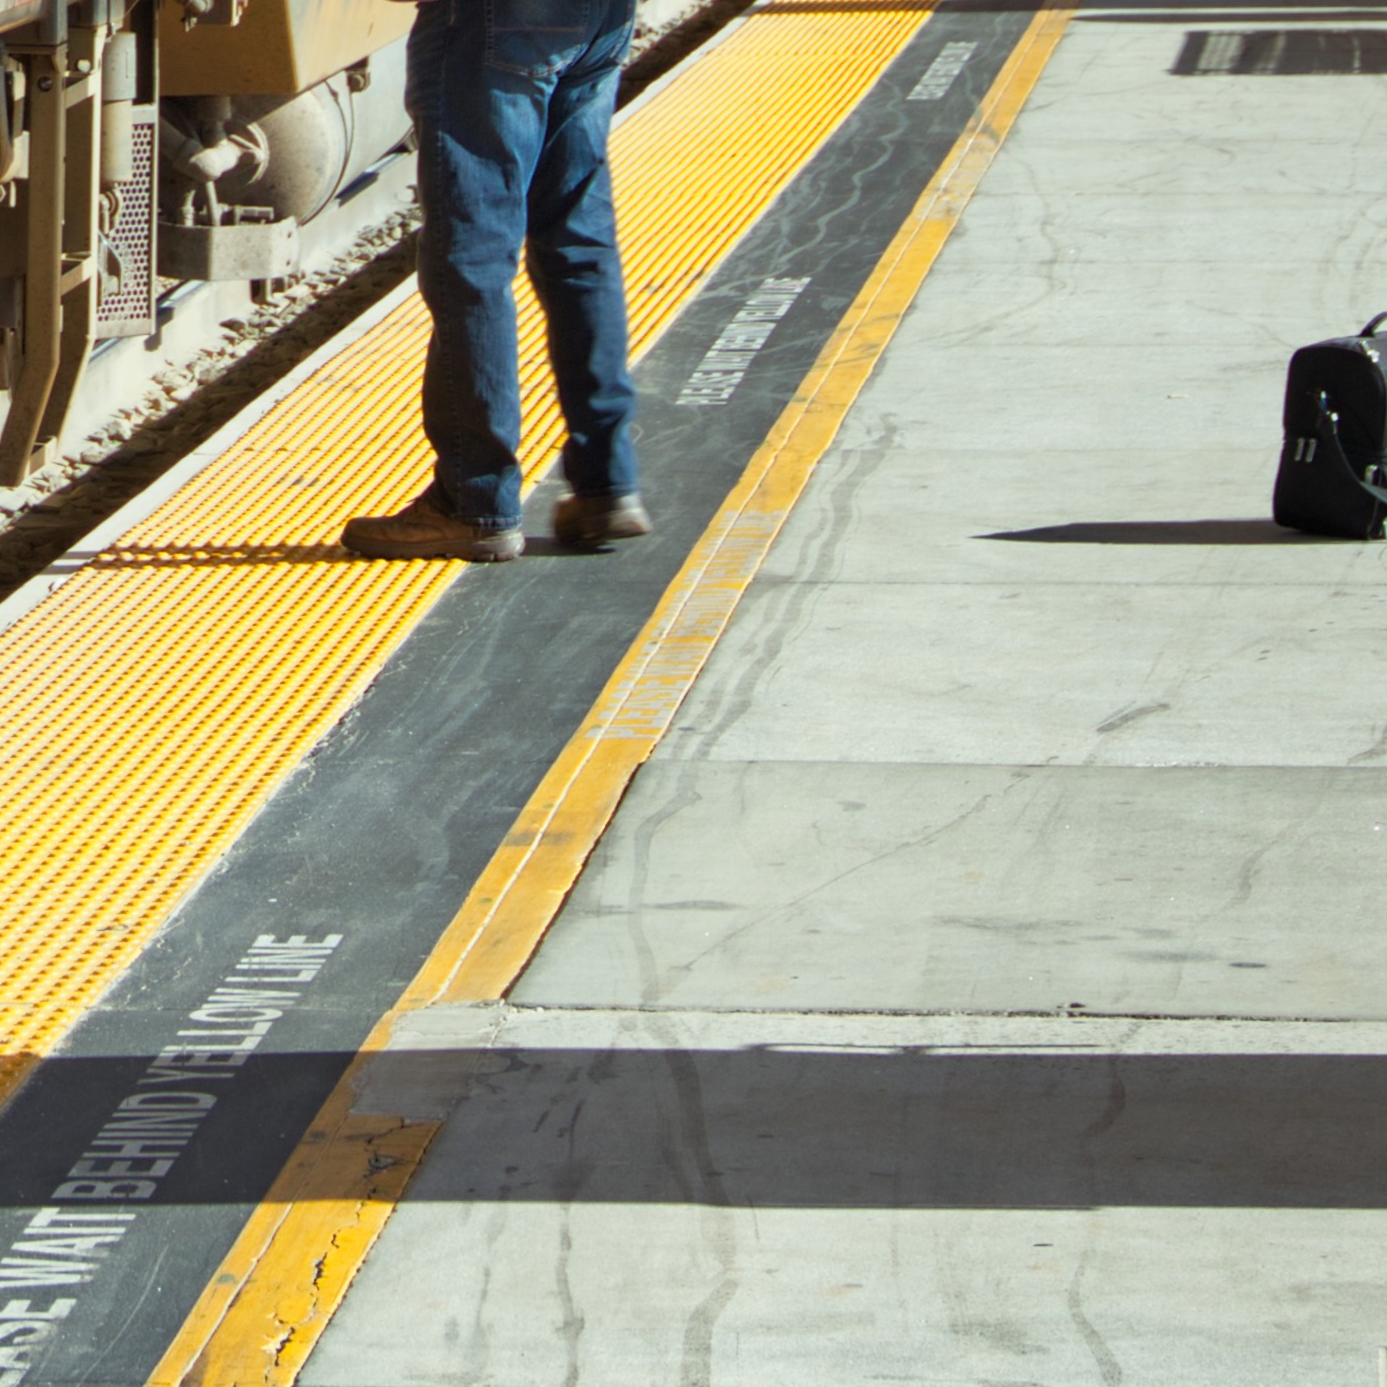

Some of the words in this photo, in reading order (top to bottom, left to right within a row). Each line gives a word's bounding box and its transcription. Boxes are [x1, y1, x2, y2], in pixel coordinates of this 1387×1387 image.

[50, 1091, 218, 1199] BEHIND
[136, 987, 302, 1085] YELLOW
[224, 933, 345, 982] LINE
